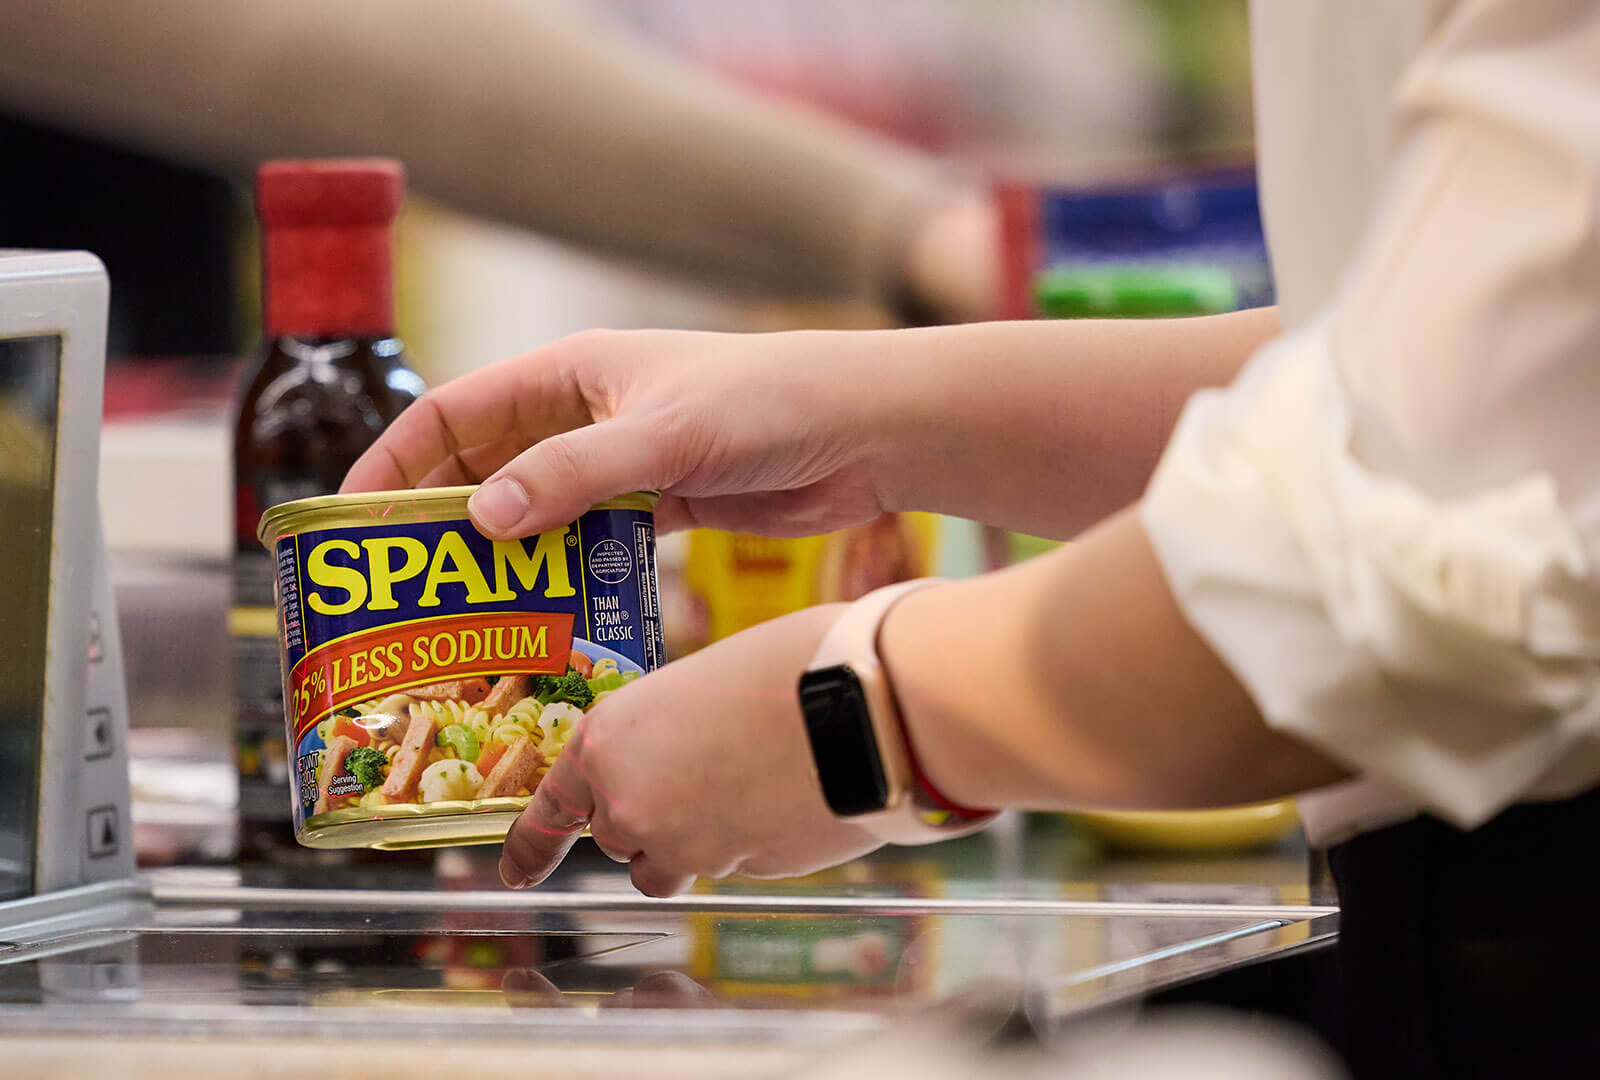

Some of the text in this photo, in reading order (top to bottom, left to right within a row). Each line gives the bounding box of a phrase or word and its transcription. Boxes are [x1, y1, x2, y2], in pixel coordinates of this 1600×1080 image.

[592, 595, 619, 611] THAN
[596, 625, 634, 642] CLASSIC
[293, 625, 549, 728] 25% LESS SODIUM
[332, 775, 357, 785] Serving
[328, 783, 364, 796] Suggestion
